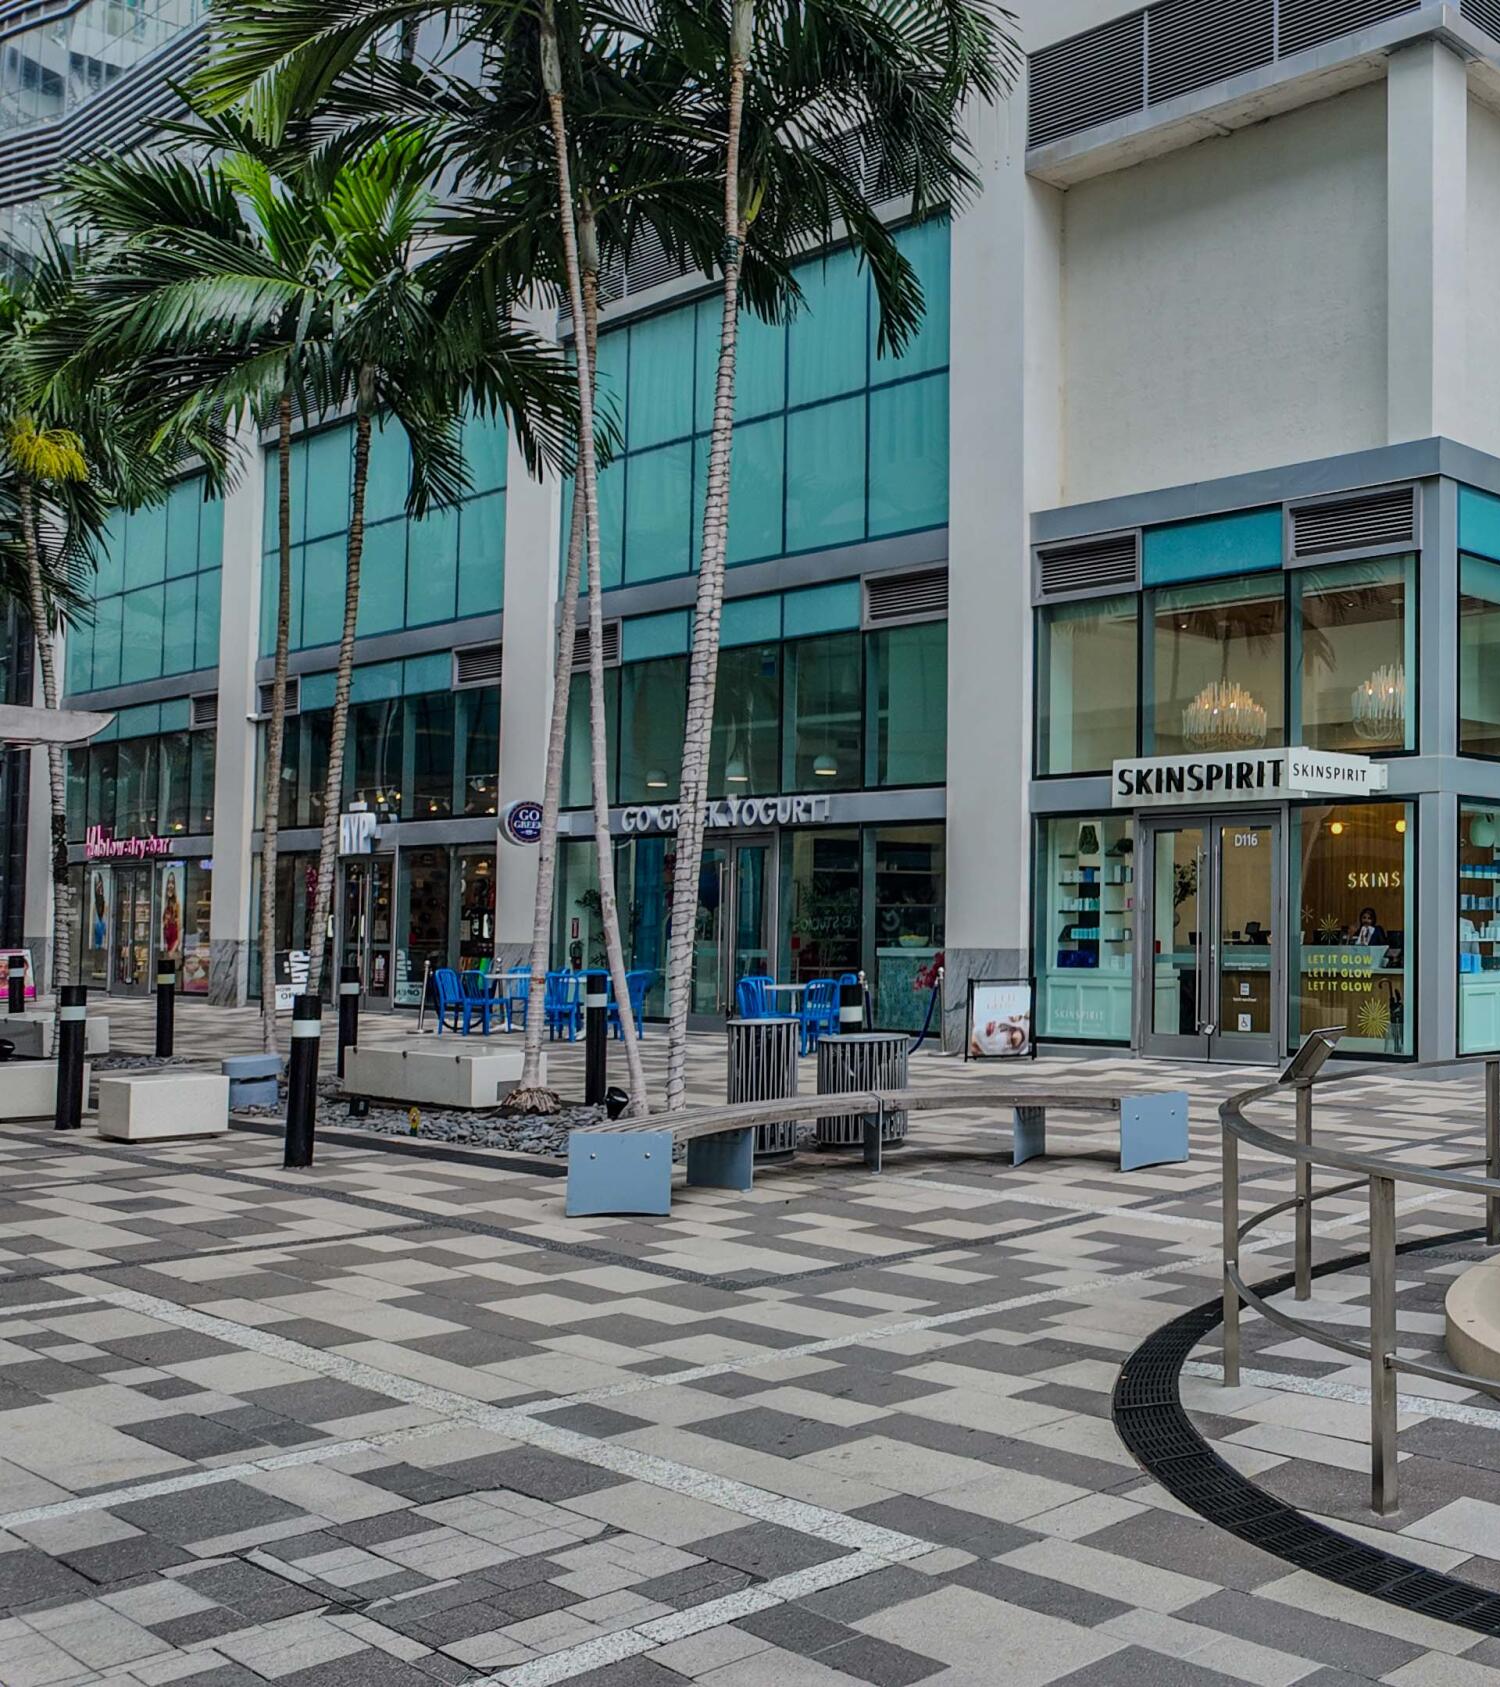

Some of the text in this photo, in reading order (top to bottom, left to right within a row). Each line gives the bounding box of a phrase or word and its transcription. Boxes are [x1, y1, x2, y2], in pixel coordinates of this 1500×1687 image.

[1117, 759, 1284, 797] SKINSPIRIT
[1292, 762, 1368, 783] SKINSPIRIT
[519, 809, 540, 821] GO
[621, 805, 650, 832] GO
[727, 796, 829, 827] YOGURT
[513, 820, 541, 829] GREE
[1234, 833, 1258, 847] D116
[1307, 954, 1372, 964] LET IT GLOW
[1307, 968, 1372, 978] LET IT GLOW
[1307, 981, 1372, 992] LET IT GLOW
